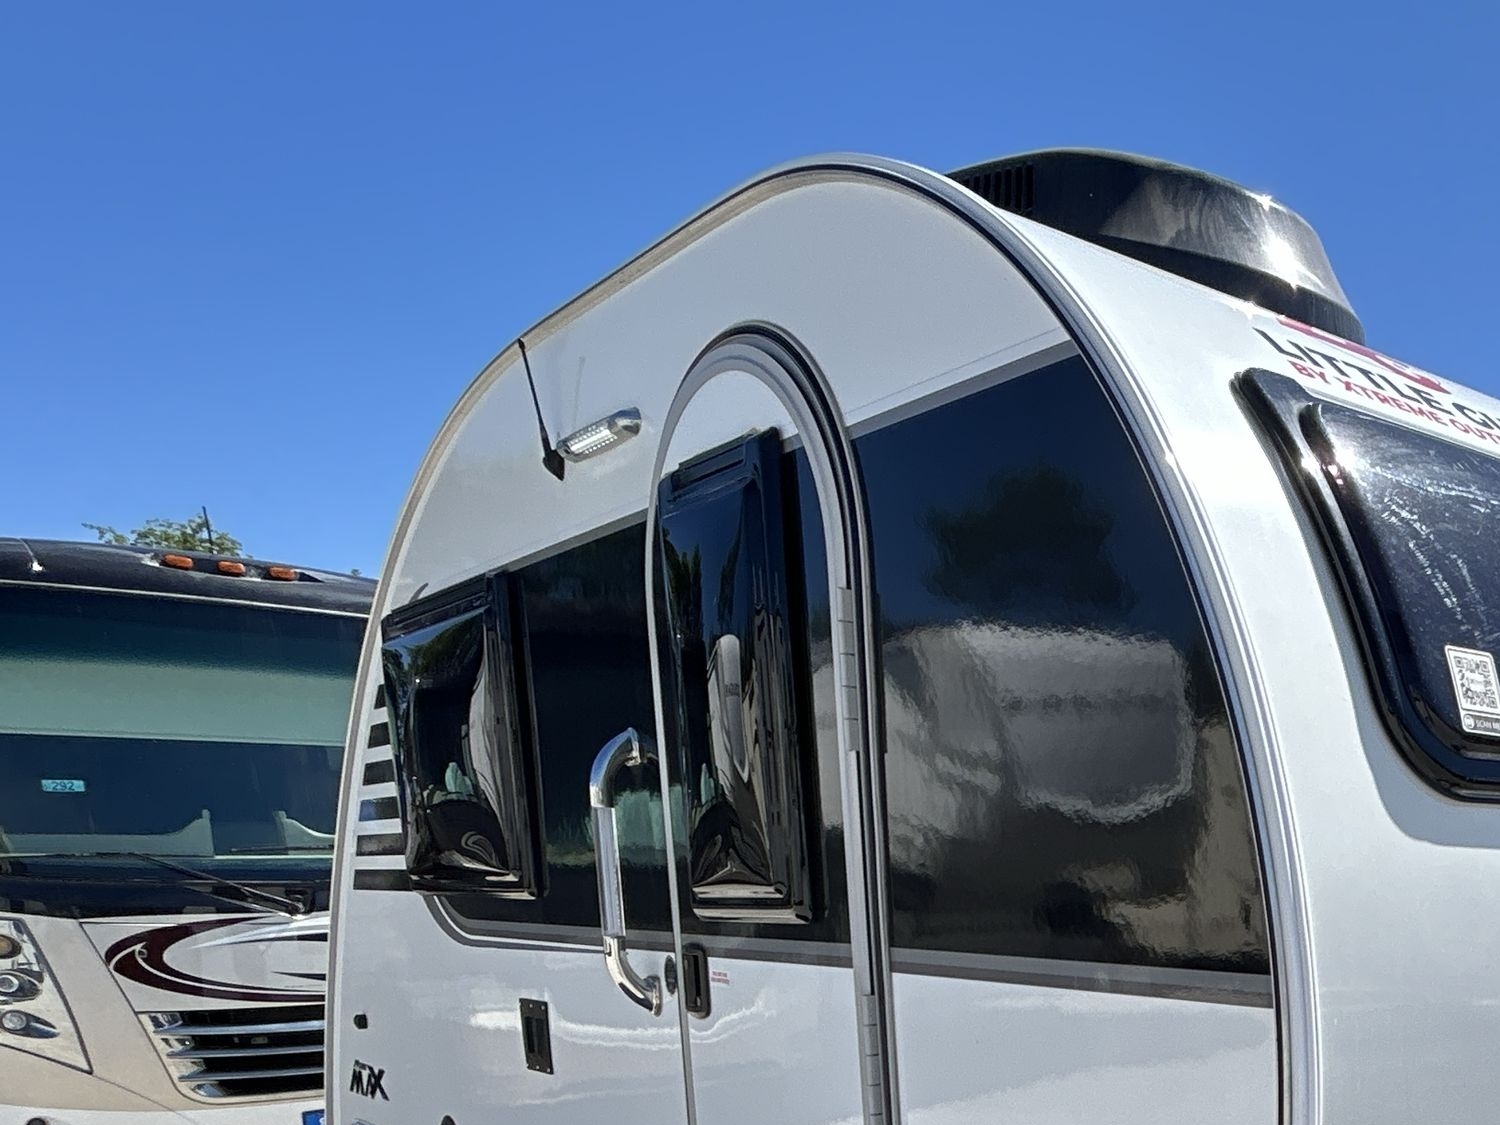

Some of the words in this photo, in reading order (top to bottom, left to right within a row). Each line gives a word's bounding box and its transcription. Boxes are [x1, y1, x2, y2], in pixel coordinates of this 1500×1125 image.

[1252, 327, 1455, 416] LITTLE
[1287, 360, 1331, 385] BY
[1333, 375, 1448, 427] XTREME
